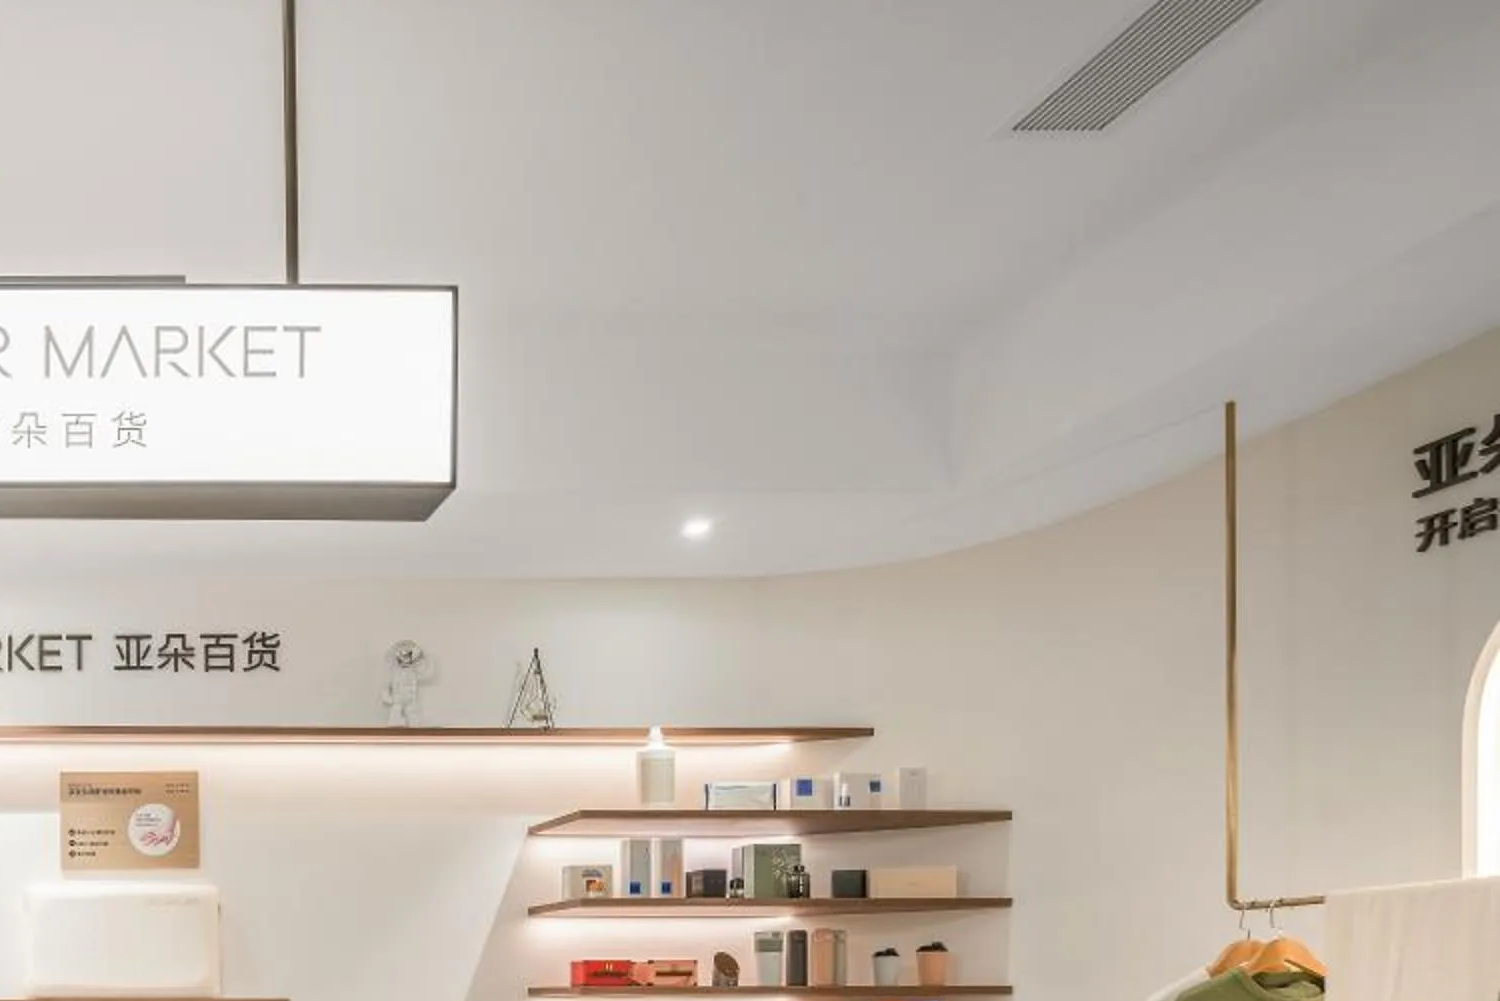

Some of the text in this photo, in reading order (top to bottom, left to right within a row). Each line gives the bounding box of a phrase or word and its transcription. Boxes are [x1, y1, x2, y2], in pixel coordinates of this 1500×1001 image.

[43, 324, 323, 380] MARKET
[113, 630, 283, 673] 亚朵百货
